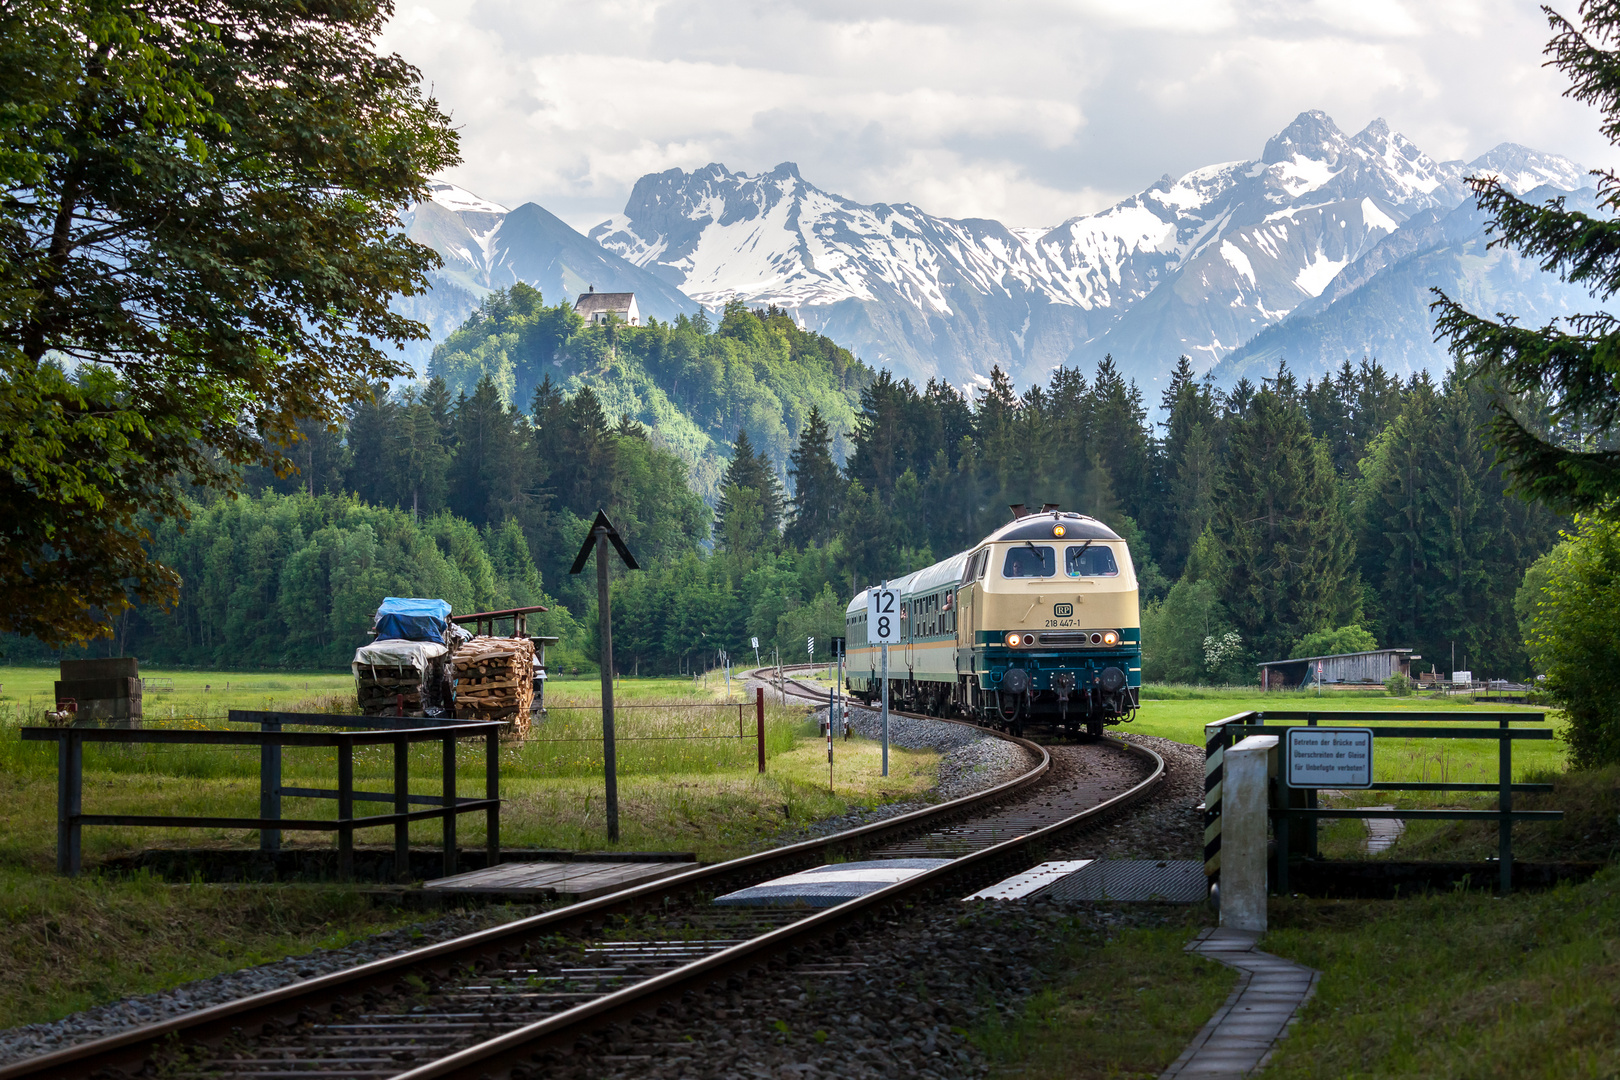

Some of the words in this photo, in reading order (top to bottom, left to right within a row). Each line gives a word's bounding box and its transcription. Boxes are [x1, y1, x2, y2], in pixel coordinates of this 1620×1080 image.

[873, 592, 895, 613] 12
[877, 616, 891, 638] 8
[1045, 619, 1058, 627] 218
[1060, 619, 1080, 627] 447-1
[1294, 738, 1318, 746] Betreten
[1320, 738, 1330, 746] der
[1333, 738, 1352, 746] Brücke
[1294, 750, 1333, 759] Überschreiten
[1336, 751, 1345, 759] der
[1348, 751, 1365, 759] Gleise
[1294, 763, 1303, 771] für
[1306, 763, 1335, 773] Unbefugte
